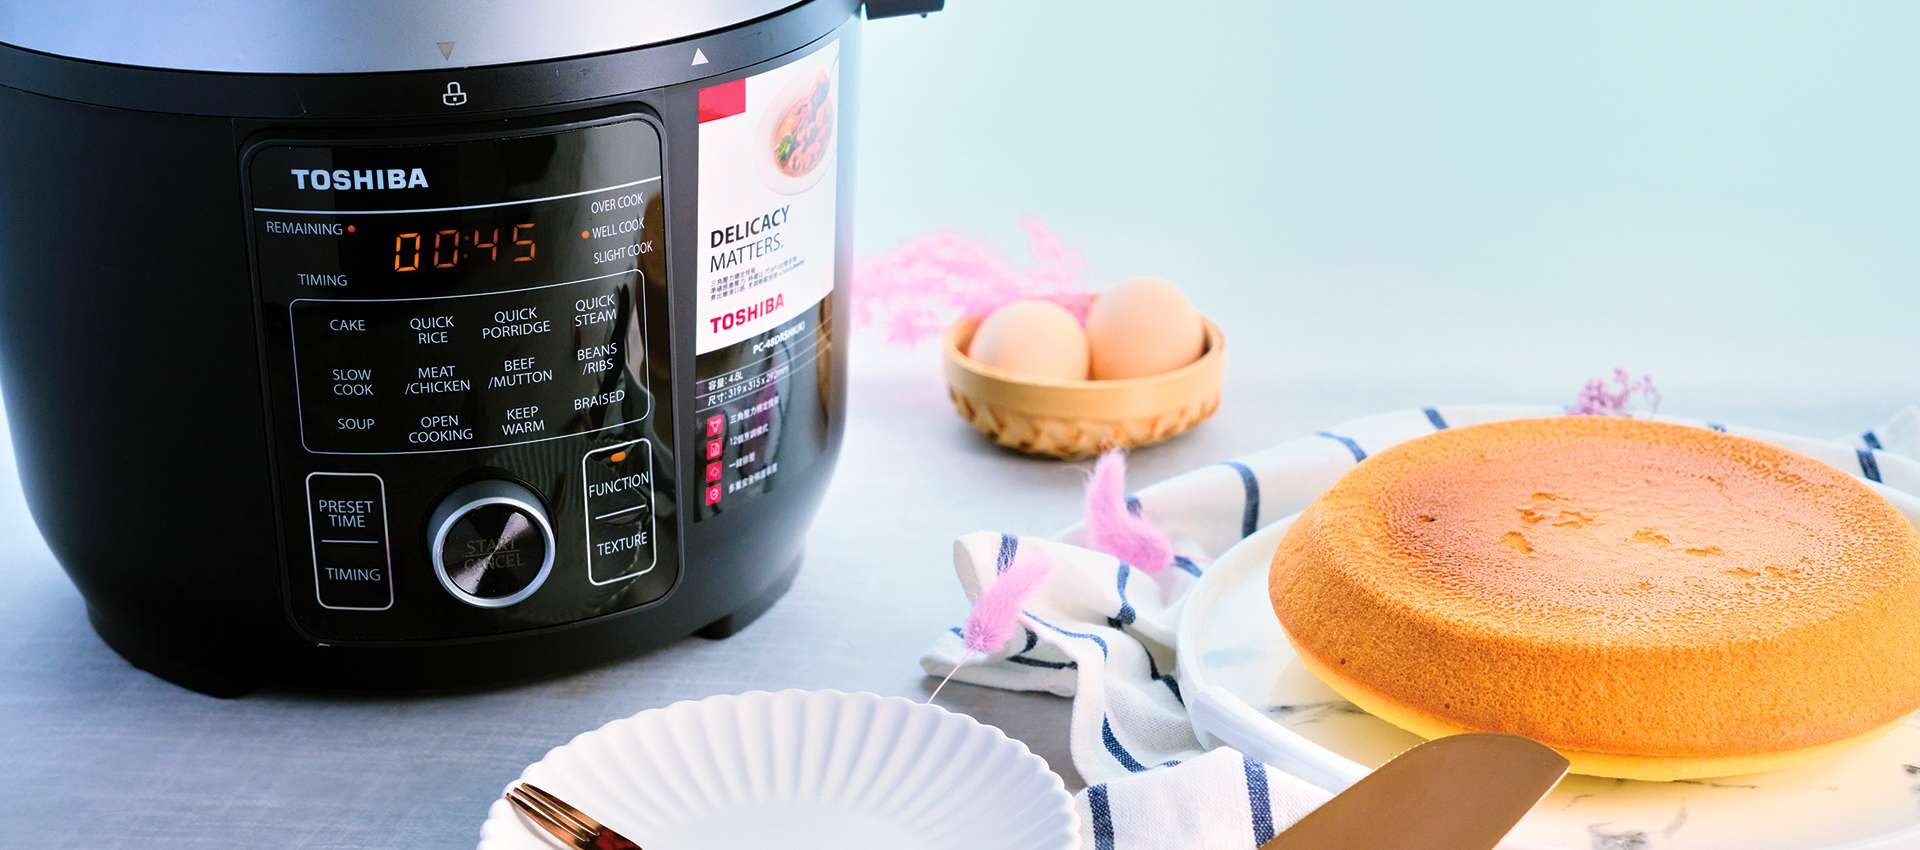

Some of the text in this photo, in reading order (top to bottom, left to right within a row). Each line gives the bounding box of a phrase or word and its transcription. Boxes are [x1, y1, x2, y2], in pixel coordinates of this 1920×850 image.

[291, 168, 429, 190] TOSHIBA
[591, 192, 643, 214] OVER COOK
[266, 221, 343, 235] REMAINING
[592, 218, 645, 239] WELL COOK
[711, 205, 790, 248] DELICACY
[593, 240, 653, 264] SLIGHT COOK
[710, 233, 784, 272] MATTERS.
[298, 274, 348, 287] TIMING
[575, 294, 615, 312] QUICK
[494, 308, 537, 324] QUICK
[575, 310, 617, 326] STEAM
[710, 293, 784, 333] TOSHIBA
[330, 319, 365, 332] CAKE
[410, 316, 454, 330] QUICK
[482, 321, 551, 340] PORRIDGE
[418, 332, 448, 344] RICE
[577, 343, 617, 361] BEANS
[418, 366, 455, 379] MEAT
[504, 357, 535, 372] BEEF
[582, 359, 614, 376] /RIBS
[333, 369, 372, 382] SLOW
[488, 371, 552, 389] /MUTTON
[334, 383, 374, 396] COOK
[405, 380, 471, 395] /CHICKEN
[574, 390, 625, 411] BRAISED
[507, 406, 538, 420] KEEP
[338, 418, 375, 431] SOUP
[421, 415, 459, 429] OPEN
[502, 420, 545, 436] WARM
[408, 429, 473, 444] COOKING
[588, 471, 649, 498] FUNCTION
[319, 500, 374, 514] PRESET
[328, 514, 366, 528] TIME
[597, 532, 647, 556] TEXTURE
[464, 553, 526, 570] CNCEL
[325, 568, 380, 582] TIMING
